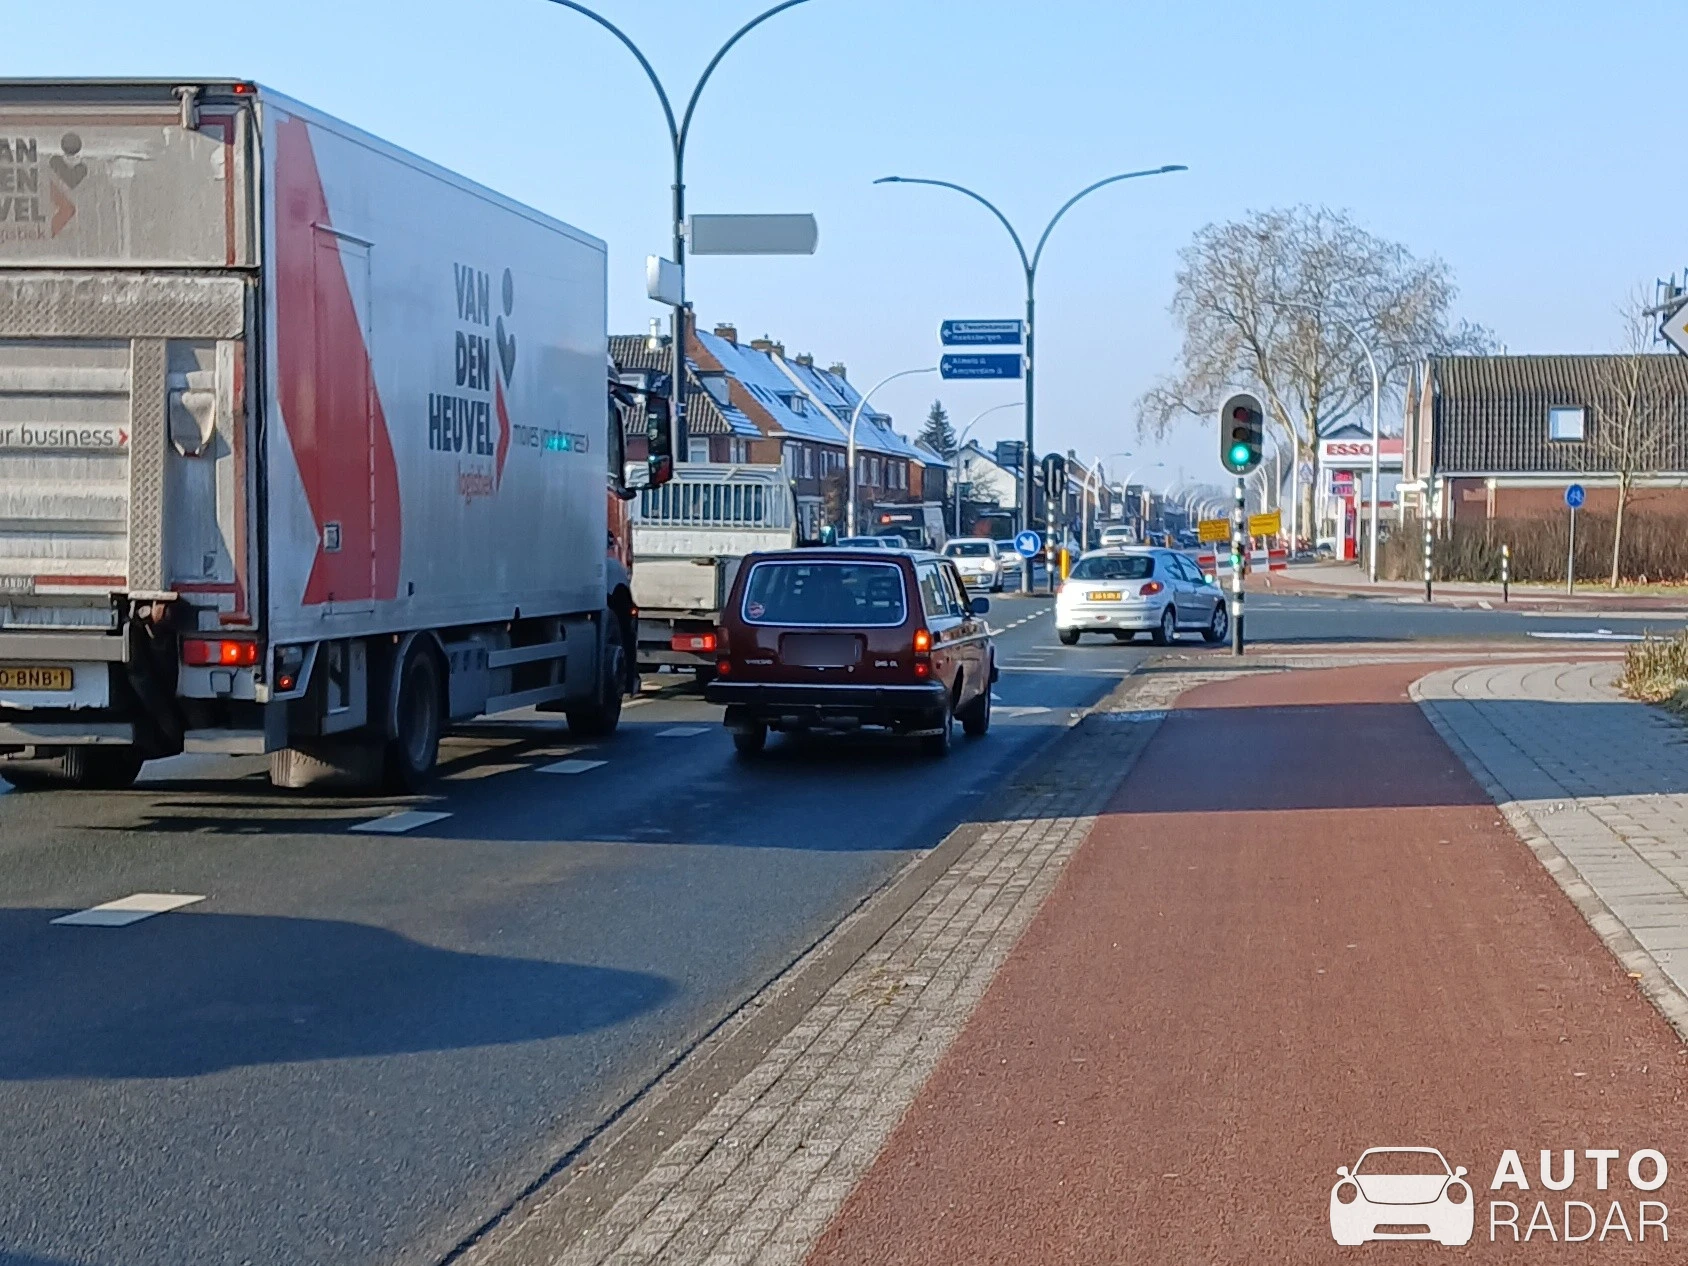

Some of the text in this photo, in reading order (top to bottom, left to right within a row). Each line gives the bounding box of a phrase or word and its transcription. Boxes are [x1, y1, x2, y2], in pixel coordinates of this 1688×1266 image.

[454, 262, 490, 327] VAN
[455, 330, 491, 392] DEN
[21, 422, 114, 446] business
[428, 392, 494, 457] HEUVEL
